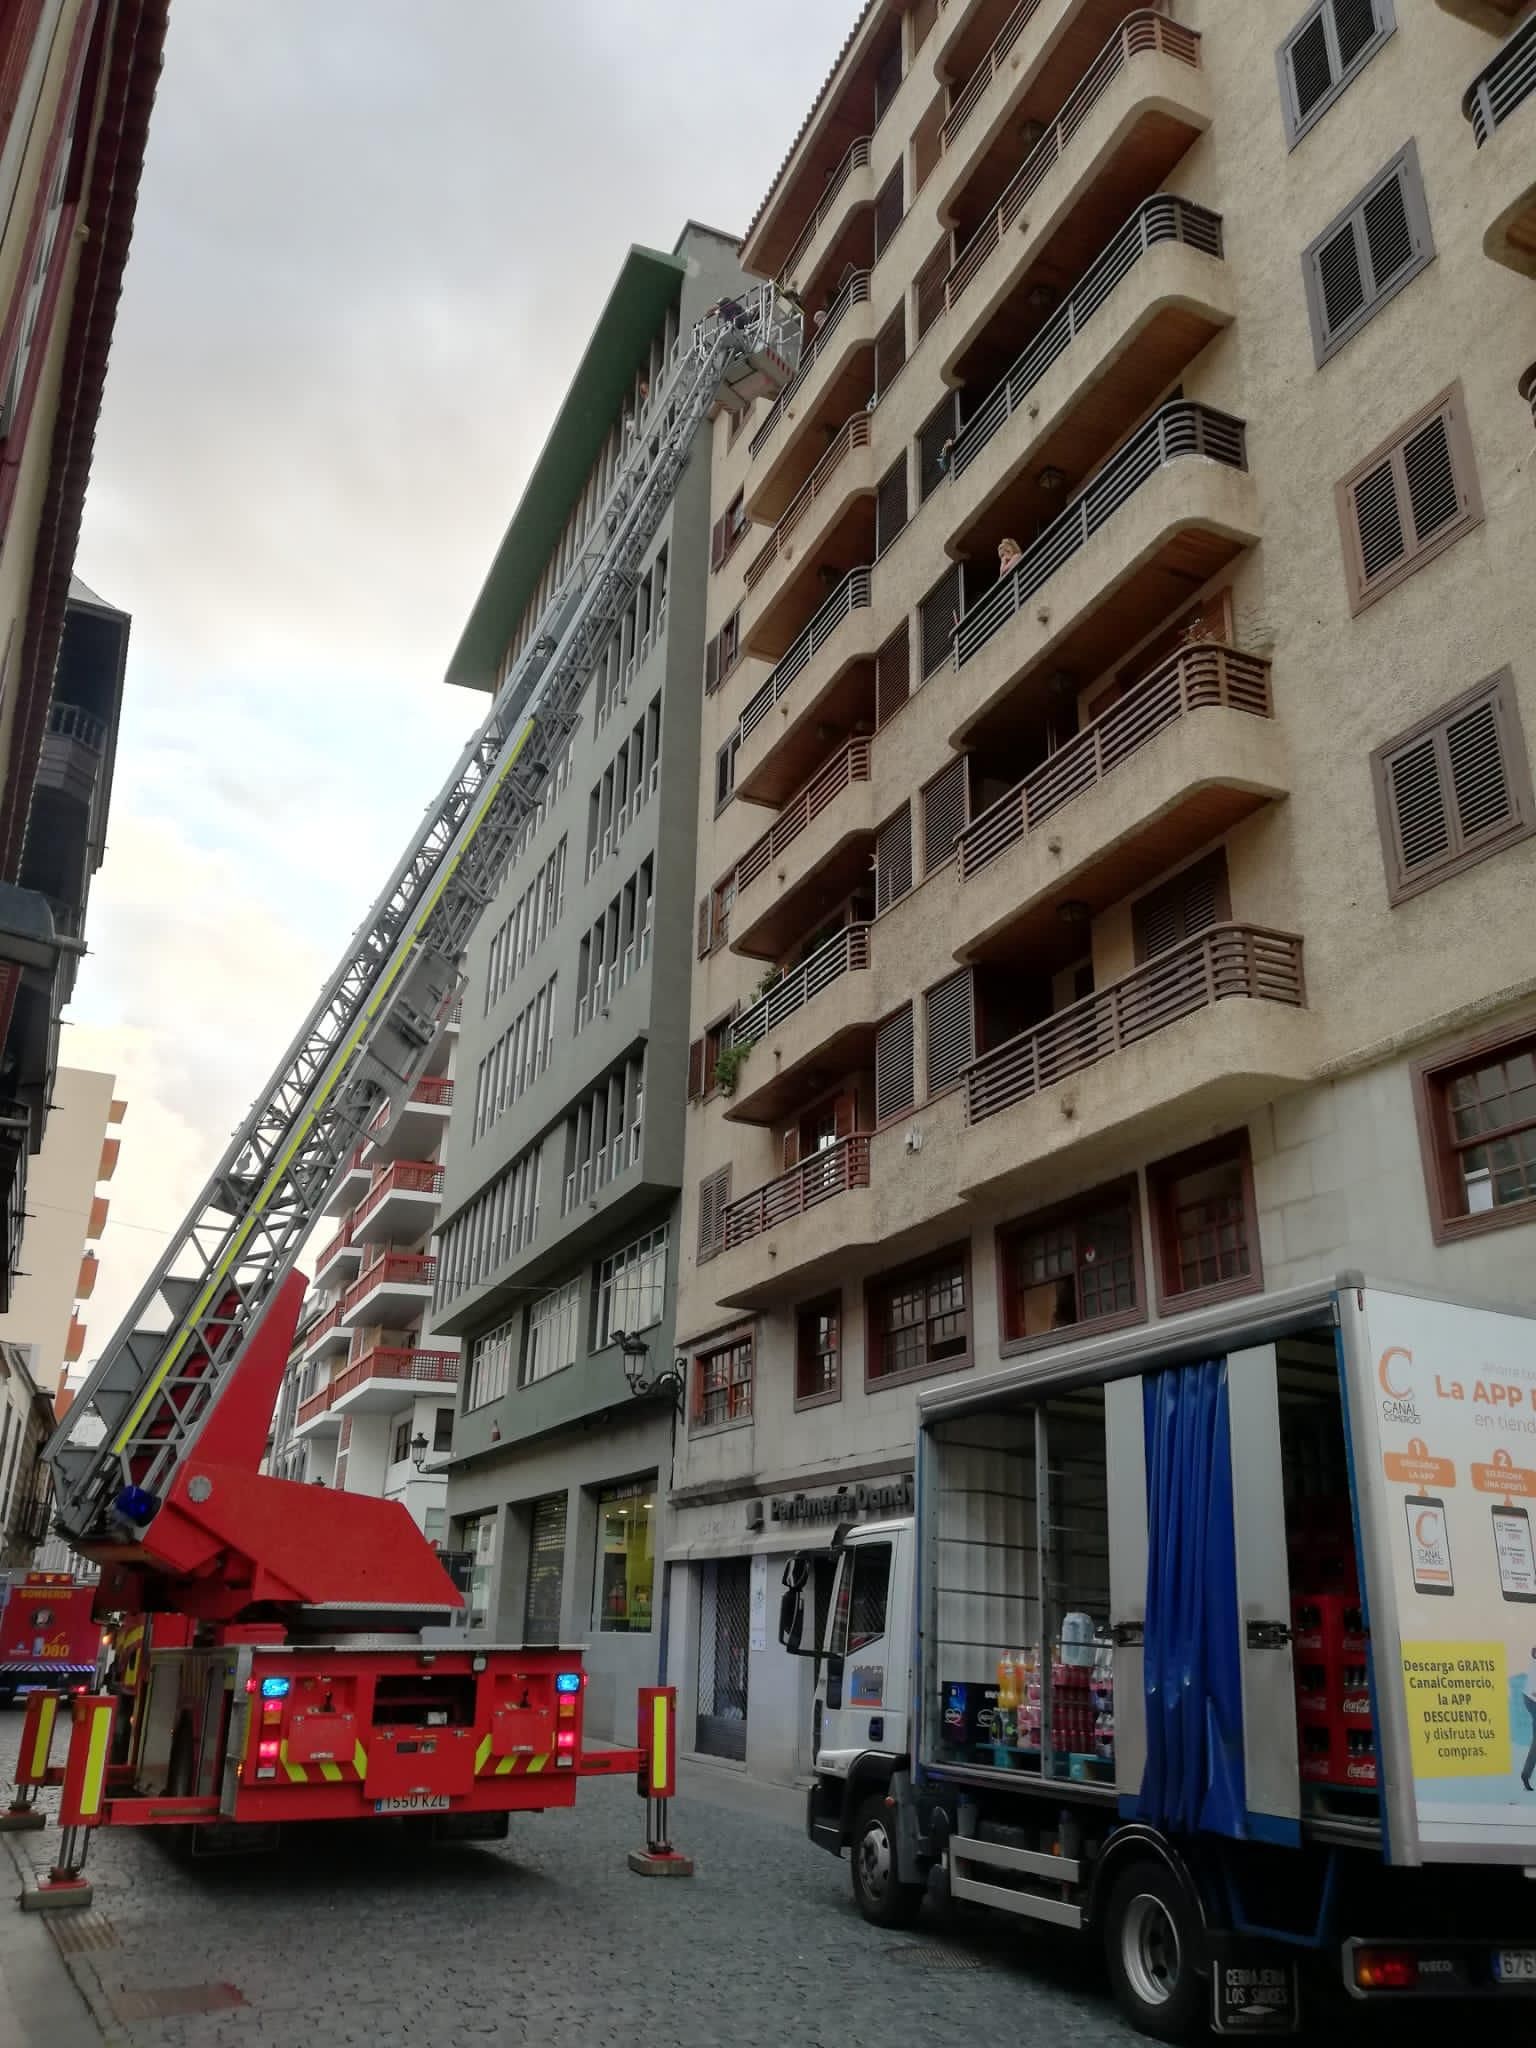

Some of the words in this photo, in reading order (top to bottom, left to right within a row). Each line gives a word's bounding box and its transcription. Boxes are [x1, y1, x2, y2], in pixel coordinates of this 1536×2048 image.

[1434, 1374, 1465, 1401] La
[1383, 1401, 1421, 1417] CANAL
[1404, 1660, 1454, 1674] Descarga
[1457, 1660, 1495, 1672] GRATIS
[1409, 1676, 1494, 1691] CanalComercio,
[1437, 1693, 1448, 1705] la
[1451, 1693, 1471, 1705] APP
[1423, 1710, 1491, 1725] DESCUENTO,
[1424, 1729, 1430, 1744] y
[1433, 1727, 1476, 1740] disfruta
[1478, 1727, 1495, 1739] tus
[1438, 1746, 1488, 1760] compras.
